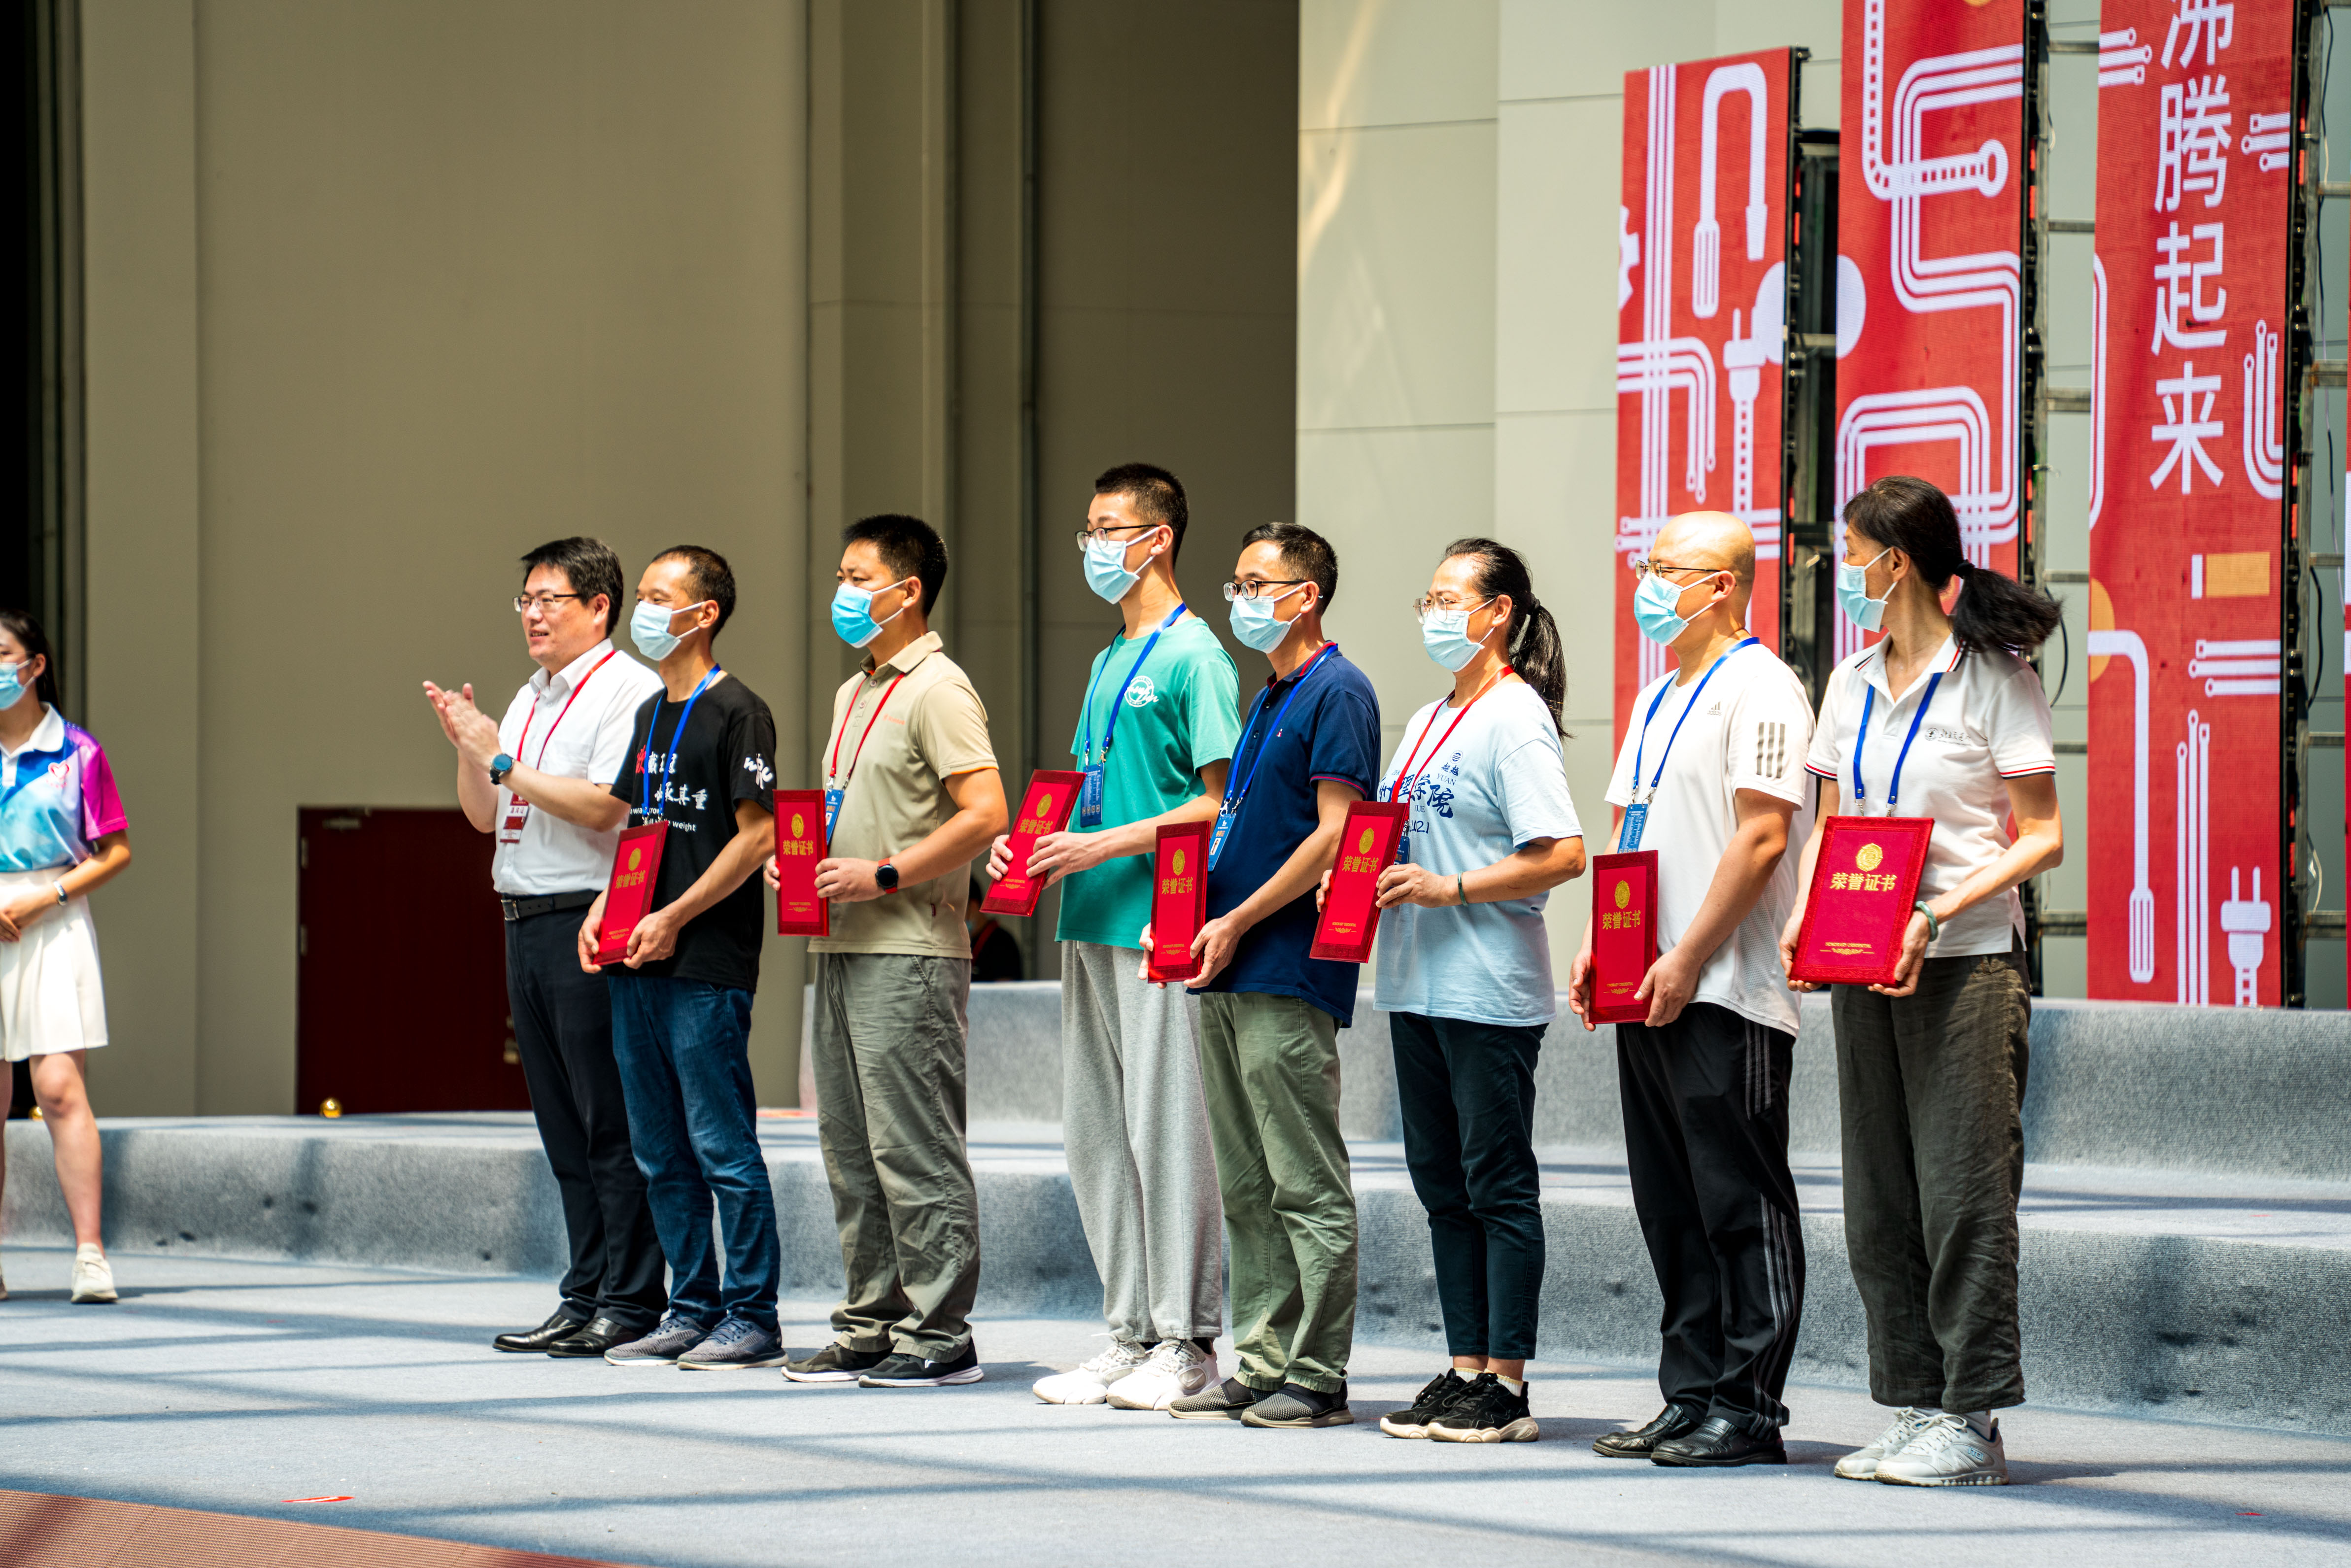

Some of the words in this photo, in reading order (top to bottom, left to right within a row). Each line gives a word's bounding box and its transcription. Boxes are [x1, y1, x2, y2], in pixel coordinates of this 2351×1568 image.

[1436, 773, 1457, 785] YUAN
[672, 820, 697, 833] weight
[1018, 818, 1054, 835] 荣誉证书
[783, 840, 814, 855] 荣誉证书
[1342, 855, 1379, 873] 荣誉证书
[1161, 876, 1193, 895] 荣誉证书
[1829, 872, 1897, 892] 荣誉证书
[1602, 910, 1641, 930] 荣誉证书
